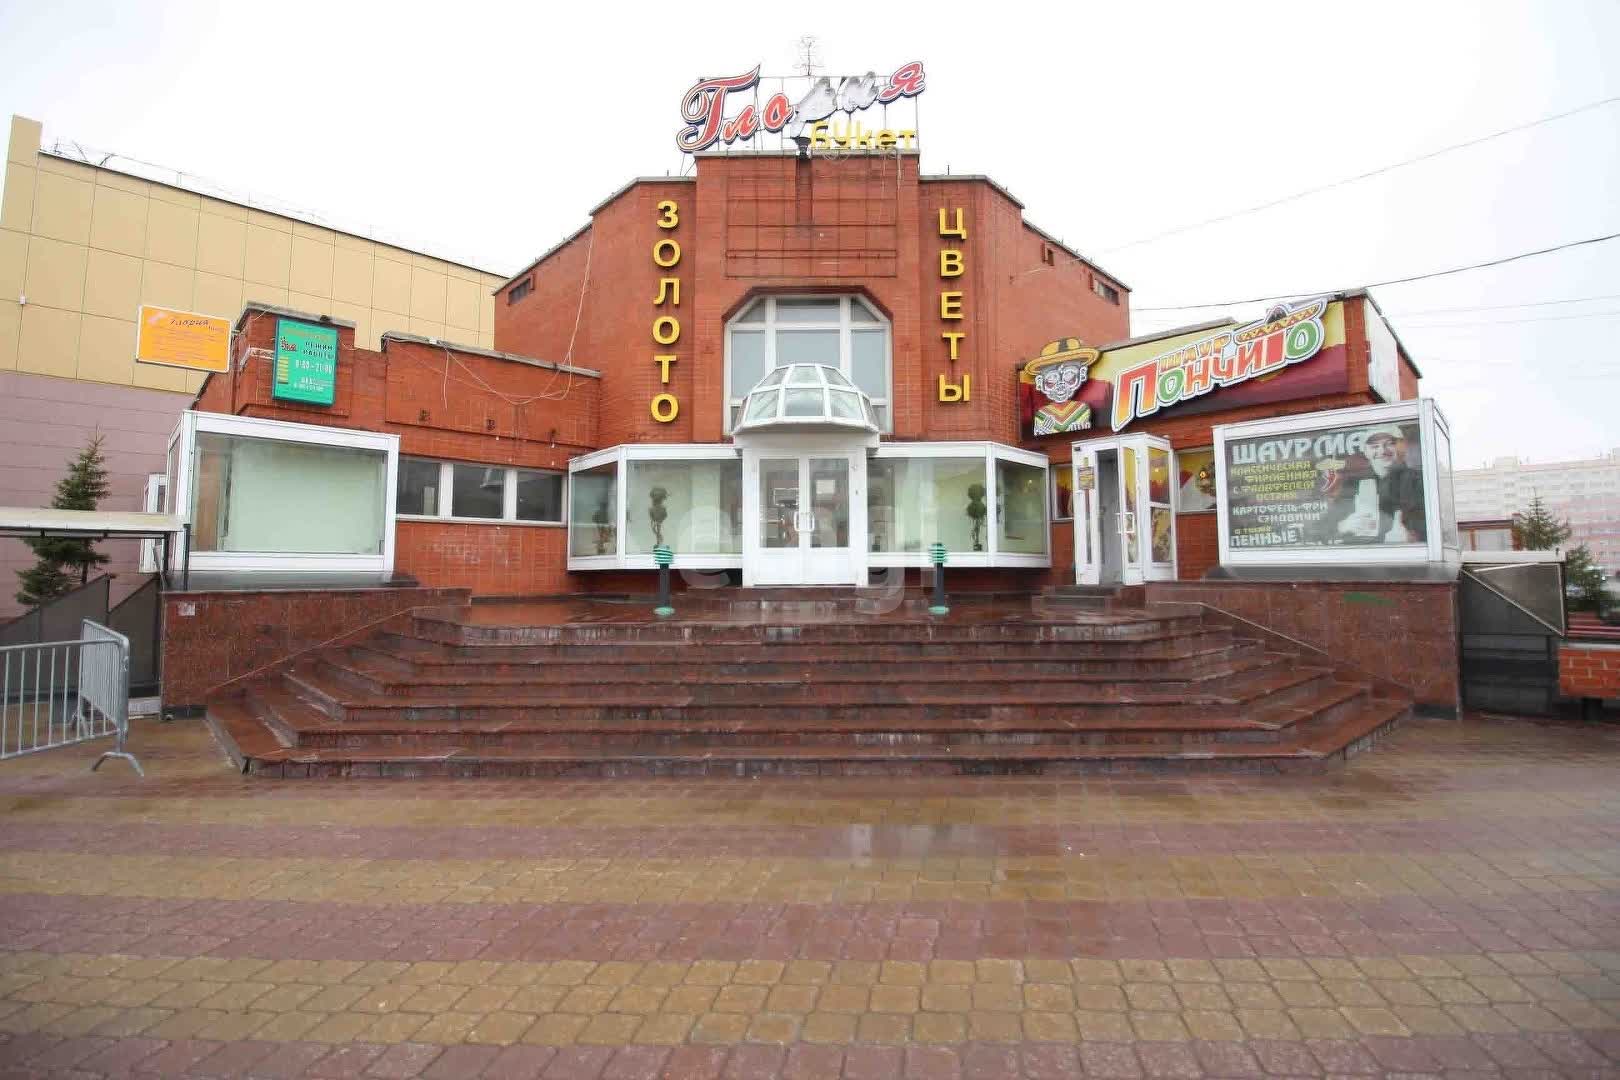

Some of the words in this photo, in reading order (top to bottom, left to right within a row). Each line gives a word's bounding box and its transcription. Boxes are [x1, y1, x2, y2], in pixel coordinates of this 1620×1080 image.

[650, 199, 682, 423] ЗОЛОТО
[937, 206, 971, 403] ЦВЕТЫ
[1159, 332, 1231, 373] ШАУР
[1232, 432, 1367, 465] ШАУРМА
